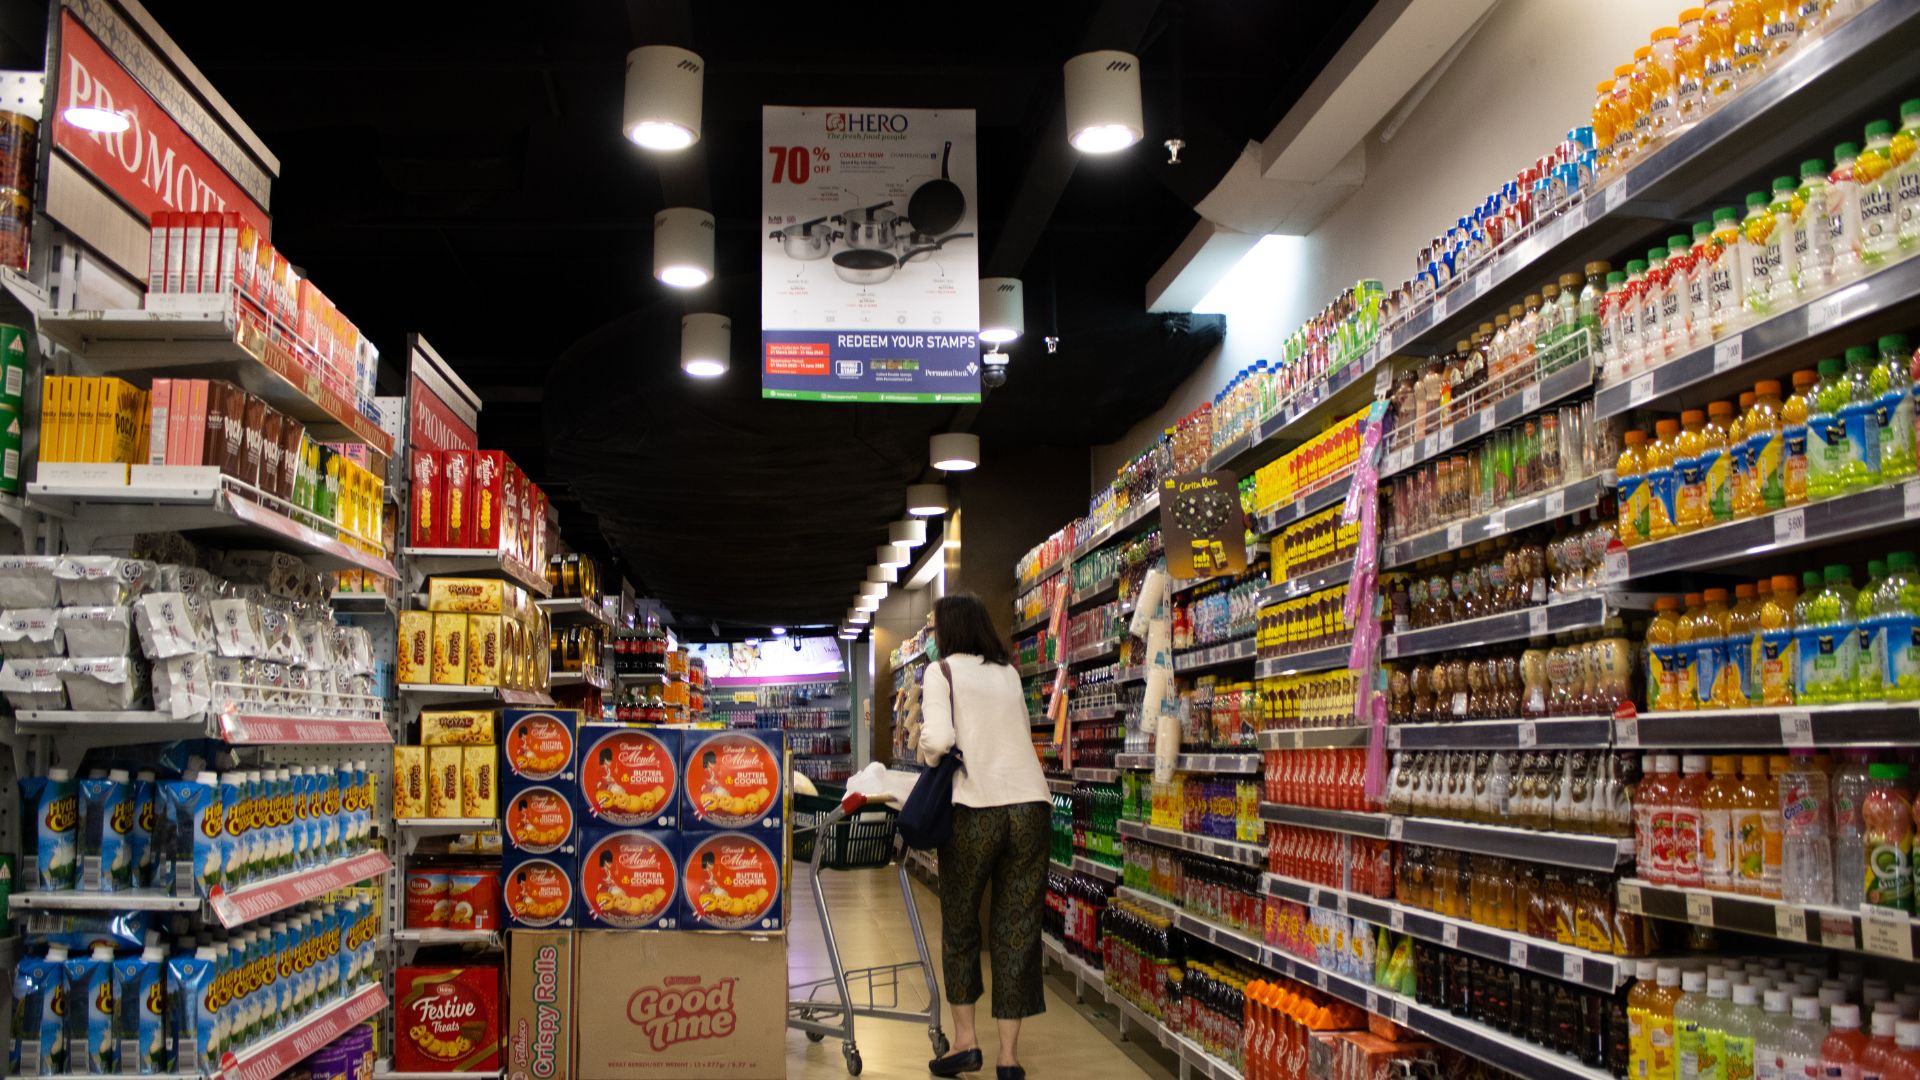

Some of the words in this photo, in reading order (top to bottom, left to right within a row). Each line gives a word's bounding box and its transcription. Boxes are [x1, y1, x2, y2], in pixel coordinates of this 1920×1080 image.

[849, 113, 908, 133] HERO
[814, 166, 831, 174] OFF
[838, 334, 888, 348] REDEEM
[890, 335, 924, 348] YOUR
[927, 335, 976, 349] STAMPS
[354, 417, 387, 449] PROMOTION
[49, 797, 77, 815] Hydr
[293, 873, 341, 898] PROMOTION
[347, 858, 386, 879] PROMOTION
[1871, 846, 1911, 878] Q
[535, 947, 557, 1002] Rolls
[413, 995, 476, 1023] Festive
[629, 979, 734, 1024] Good
[292, 1018, 339, 1055] PROMOTION
[346, 991, 382, 1022] PROMOTION
[432, 1021, 460, 1034] Treats
[644, 1010, 735, 1050] Time
[534, 1005, 560, 1078] Crispy
